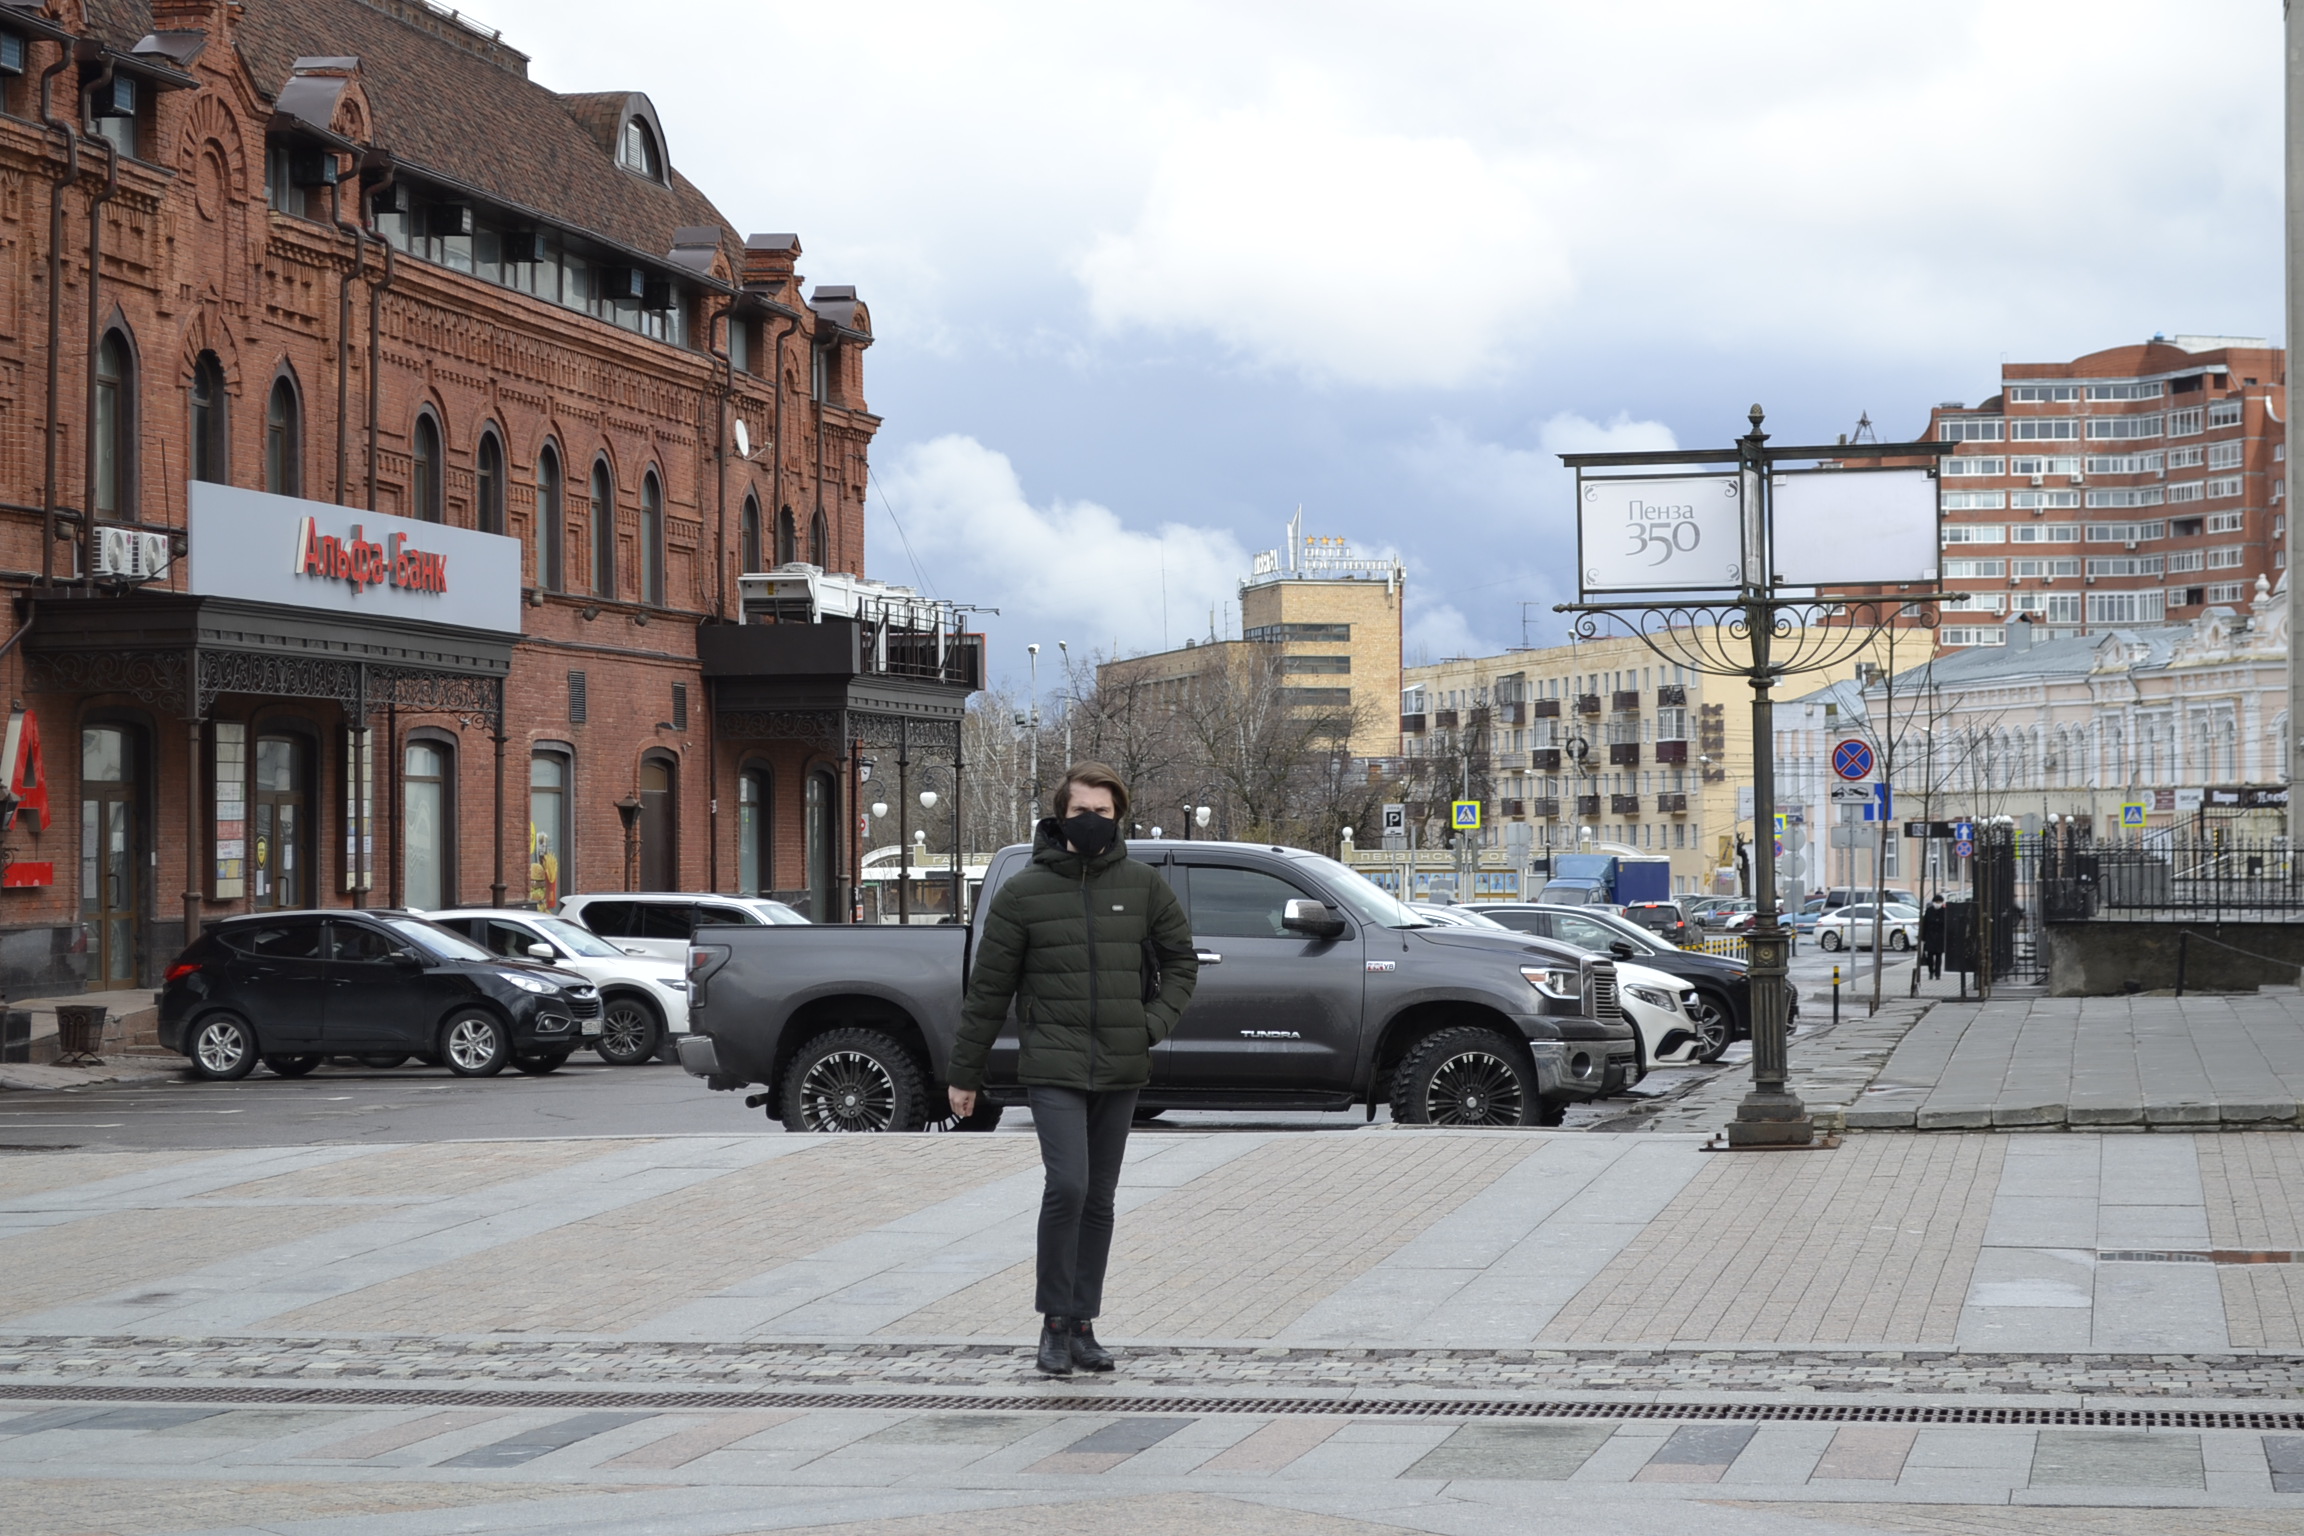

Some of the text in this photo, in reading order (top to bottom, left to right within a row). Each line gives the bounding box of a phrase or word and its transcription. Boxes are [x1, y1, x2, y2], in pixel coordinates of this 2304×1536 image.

[1629, 500, 1694, 520] Пенза
[1625, 521, 1701, 567] 350
[1304, 547, 1353, 558] HOTEL
[1240, 1030, 1301, 1039] TUNDRA
